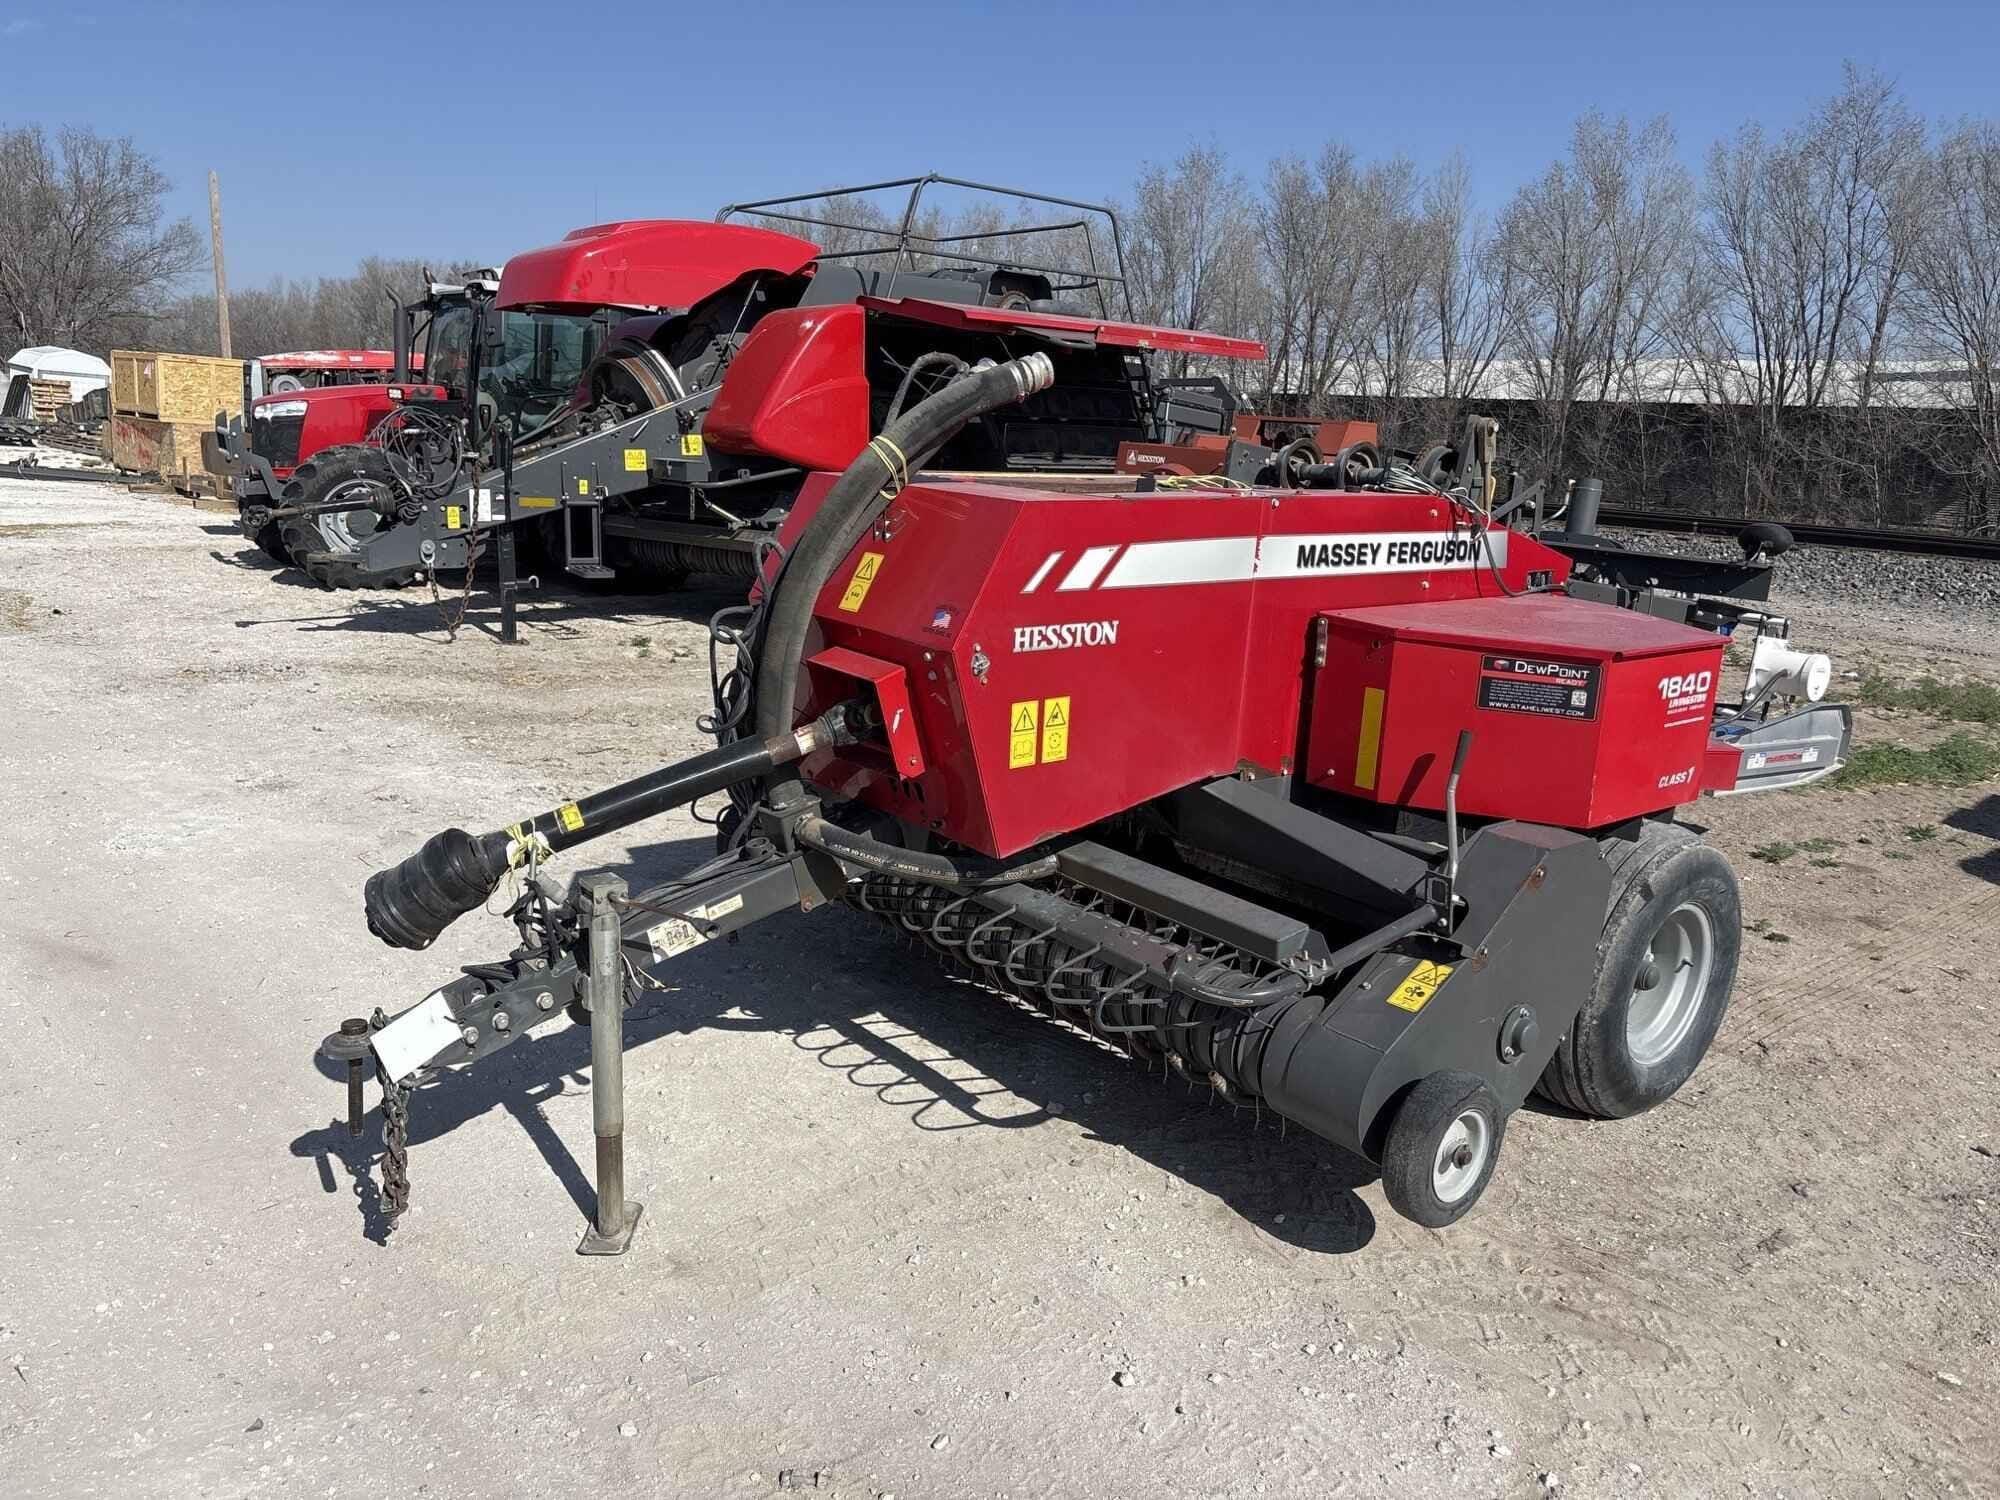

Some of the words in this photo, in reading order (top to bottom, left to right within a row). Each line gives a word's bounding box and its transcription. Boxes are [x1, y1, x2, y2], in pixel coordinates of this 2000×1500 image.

[1137, 454, 1166, 465] HESSTON
[1296, 542, 1382, 569] MASSEY
[1387, 539, 1483, 565] FERGUSON
[1013, 620, 1119, 653] HESSTON
[1658, 671, 1712, 700] 1840
[1658, 772, 1687, 788] CLASS
[1686, 766, 1695, 784] 1
